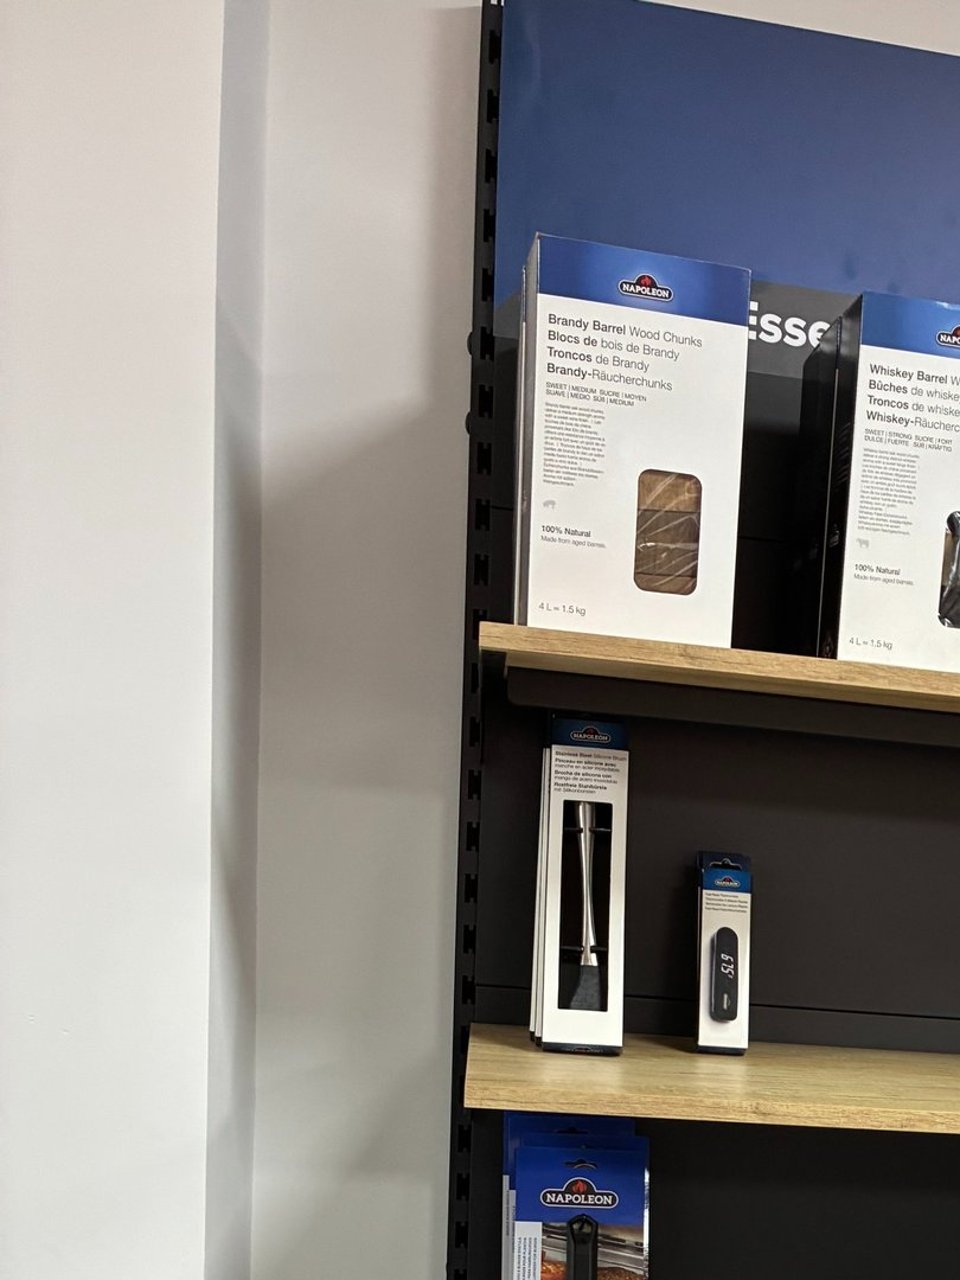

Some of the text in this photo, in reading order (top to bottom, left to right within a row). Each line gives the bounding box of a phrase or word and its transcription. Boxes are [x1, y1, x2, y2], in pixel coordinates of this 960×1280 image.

[622, 283, 670, 298] NAPOLEON
[548, 314, 703, 346] Brandy Barrel Wood Chunks
[548, 330, 680, 362] Blocs de bois de Brandy
[547, 347, 650, 374] Troncos de Brandy
[546, 363, 673, 390] Brandy-Räucherchunks
[870, 364, 914, 381] Whiskey
[917, 371, 948, 384] Barrel
[546, 382, 647, 401] SWEET MEDIUM MOYEN
[868, 380, 908, 394] Bûches
[910, 386, 923, 396] de
[610, 398, 634, 406] MEDIUM
[867, 395, 909, 409] Troncos
[912, 401, 924, 411] de
[541, 525, 591, 537] 100% Natural
[855, 564, 901, 575] 100% Natural
[575, 607, 586, 617] kg
[546, 1192, 613, 1205] NAPOLEON
